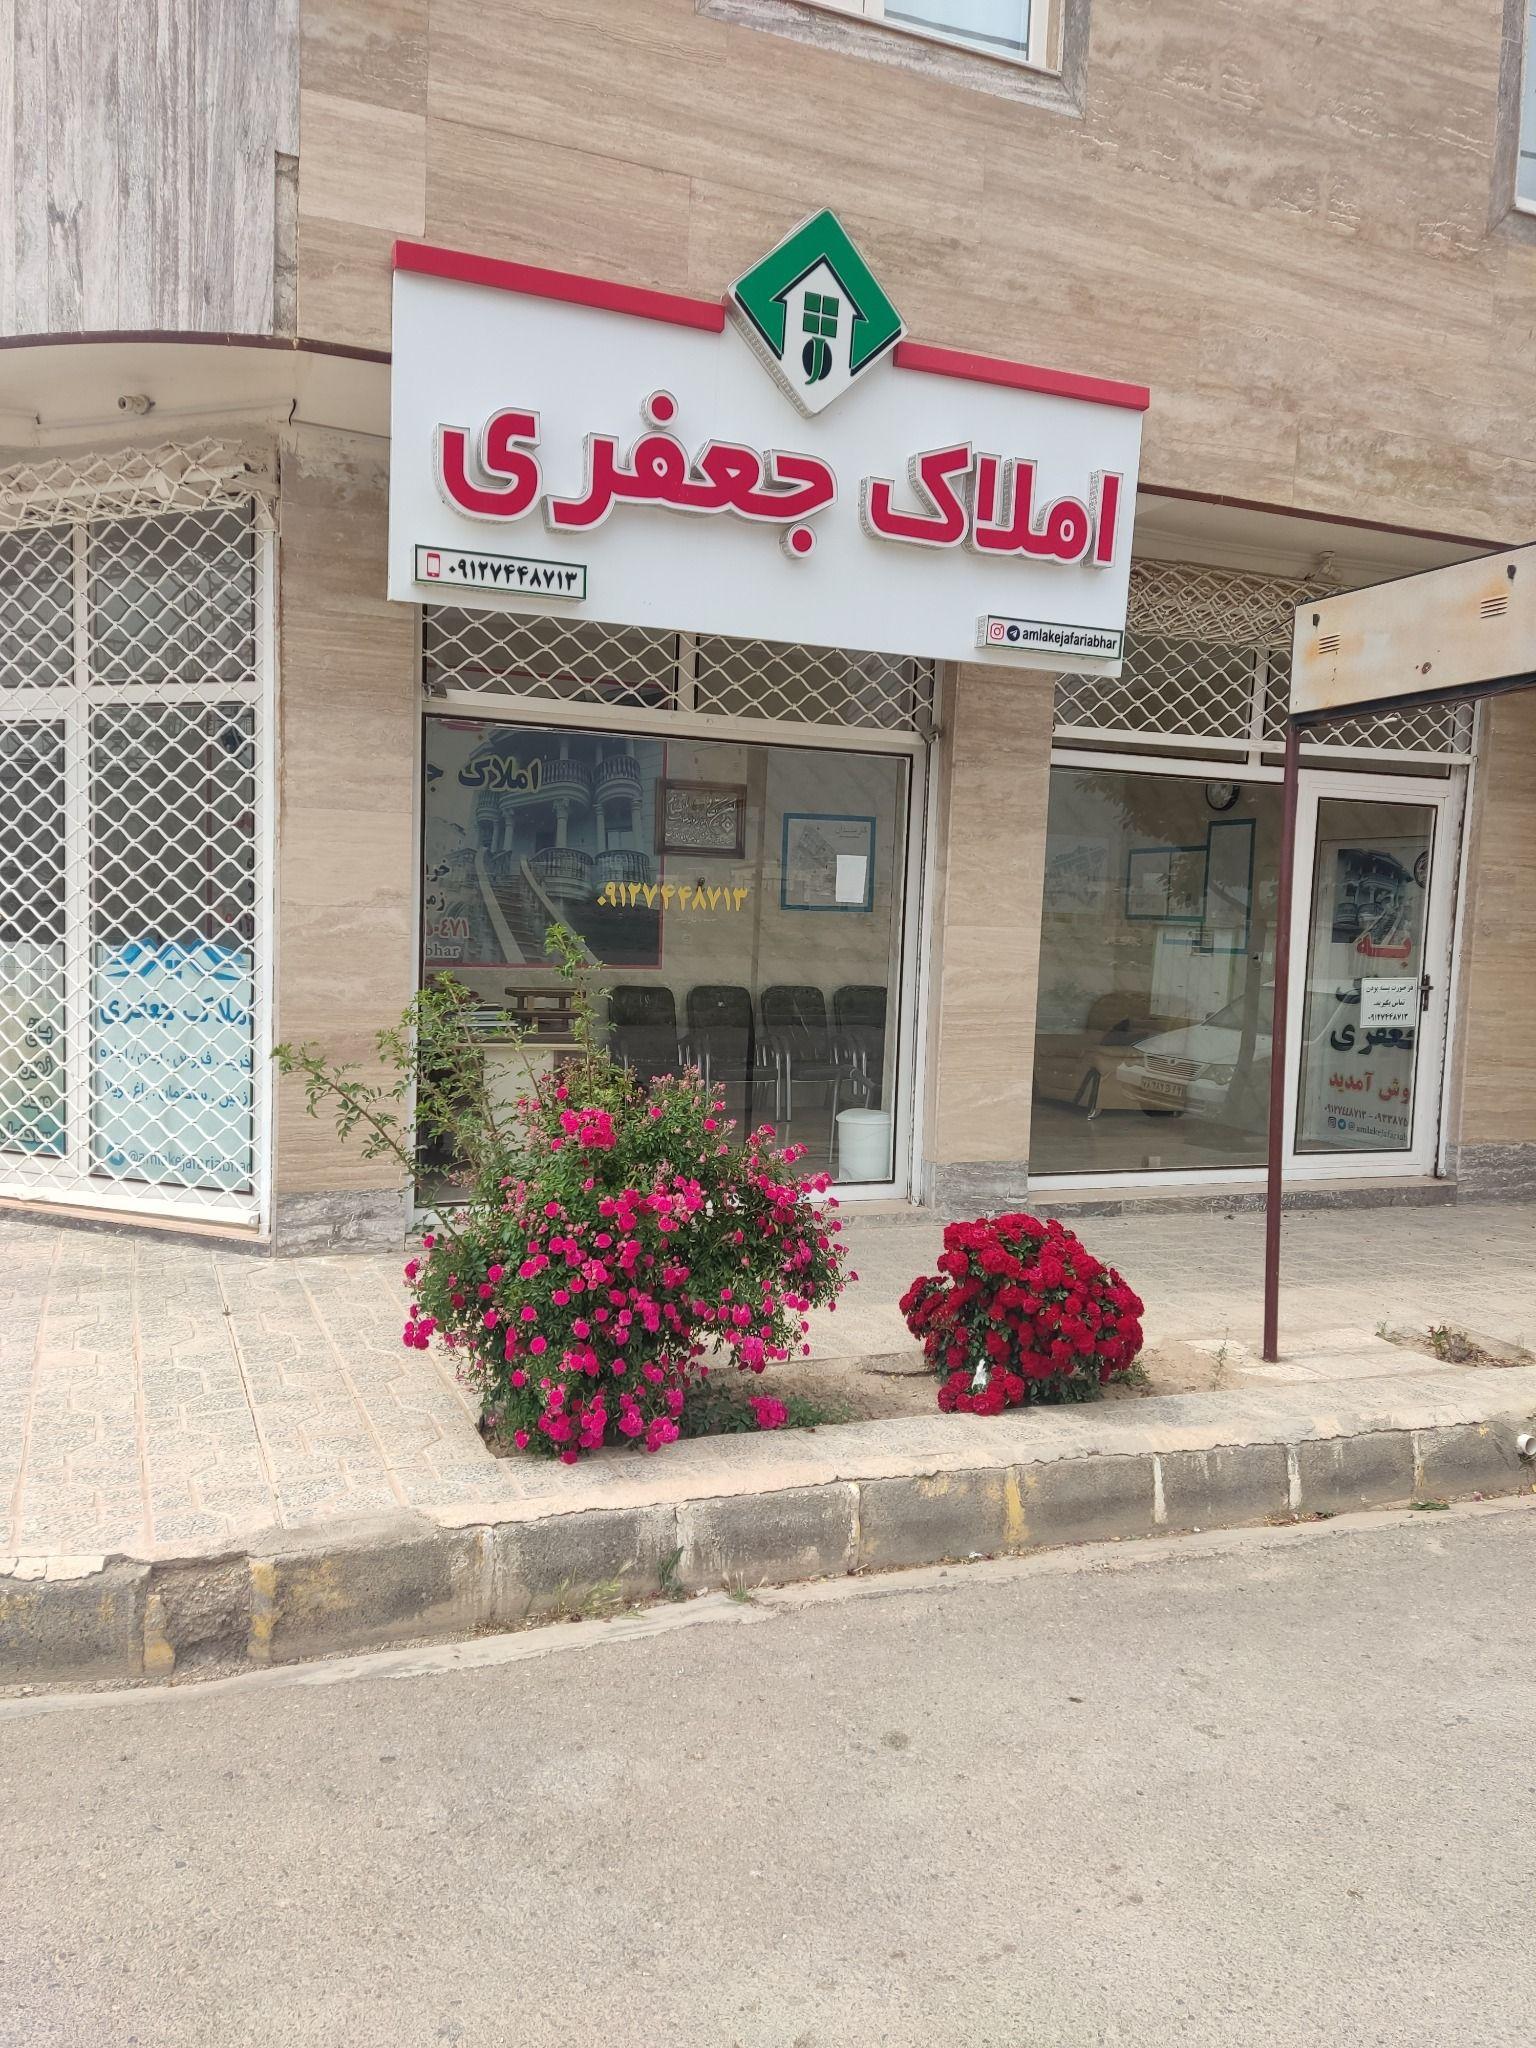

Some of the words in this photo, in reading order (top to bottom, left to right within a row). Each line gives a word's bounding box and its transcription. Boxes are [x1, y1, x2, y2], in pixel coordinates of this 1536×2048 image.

[436, 391, 837, 558] جعفری
[861, 441, 1123, 568] املاک
[448, 558, 578, 592] ۰۹۱۲۷۴۴۸۷۱۳
[1022, 628, 1118, 650] amlakejafariabhar
[458, 754, 541, 792] املاک
[596, 881, 748, 912] ۰۹۱۲۷۴۴۸۷۱۳
[1356, 933, 1413, 969] به
[1328, 1071, 1374, 1093] آمدید
